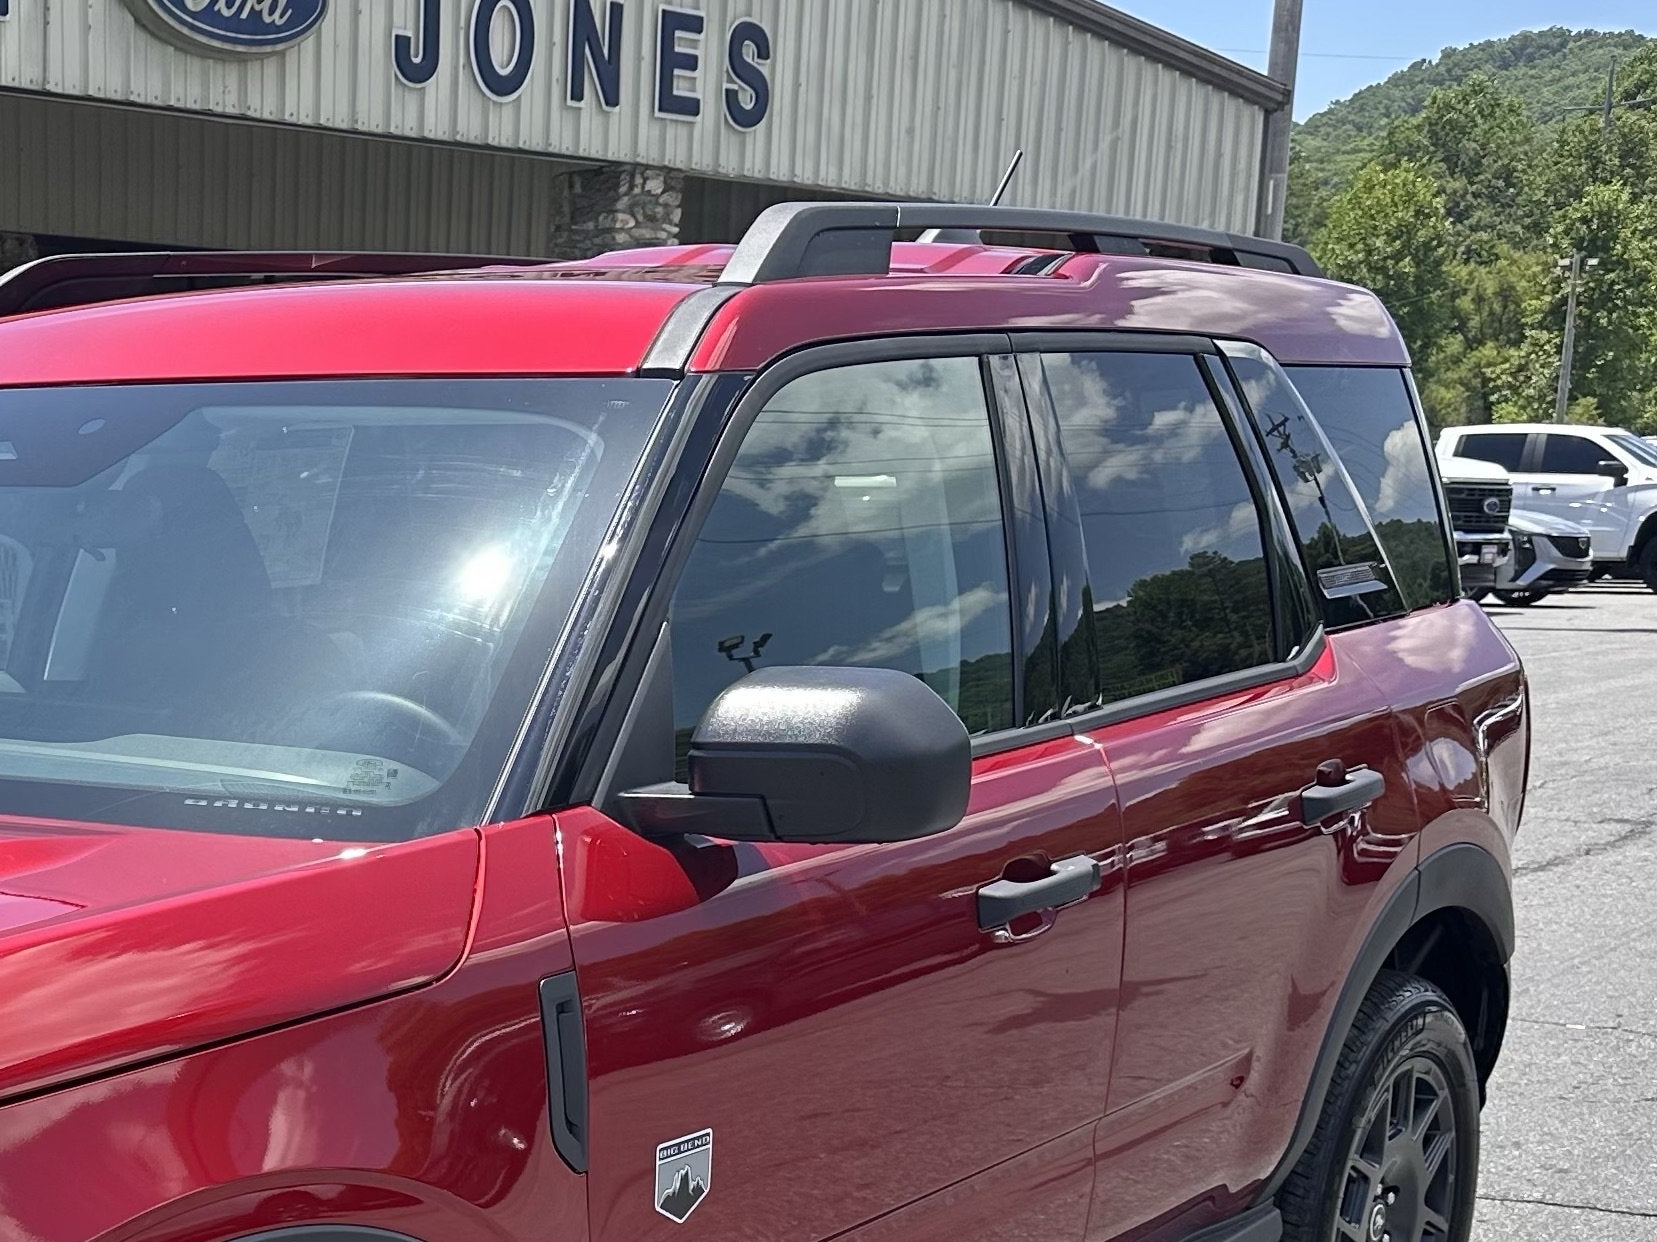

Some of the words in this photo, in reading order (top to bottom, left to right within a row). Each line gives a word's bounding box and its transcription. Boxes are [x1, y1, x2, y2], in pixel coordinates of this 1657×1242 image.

[392, 0, 772, 132] JONES
[659, 1146, 679, 1159] BIG
[680, 1136, 710, 1152] BEND
